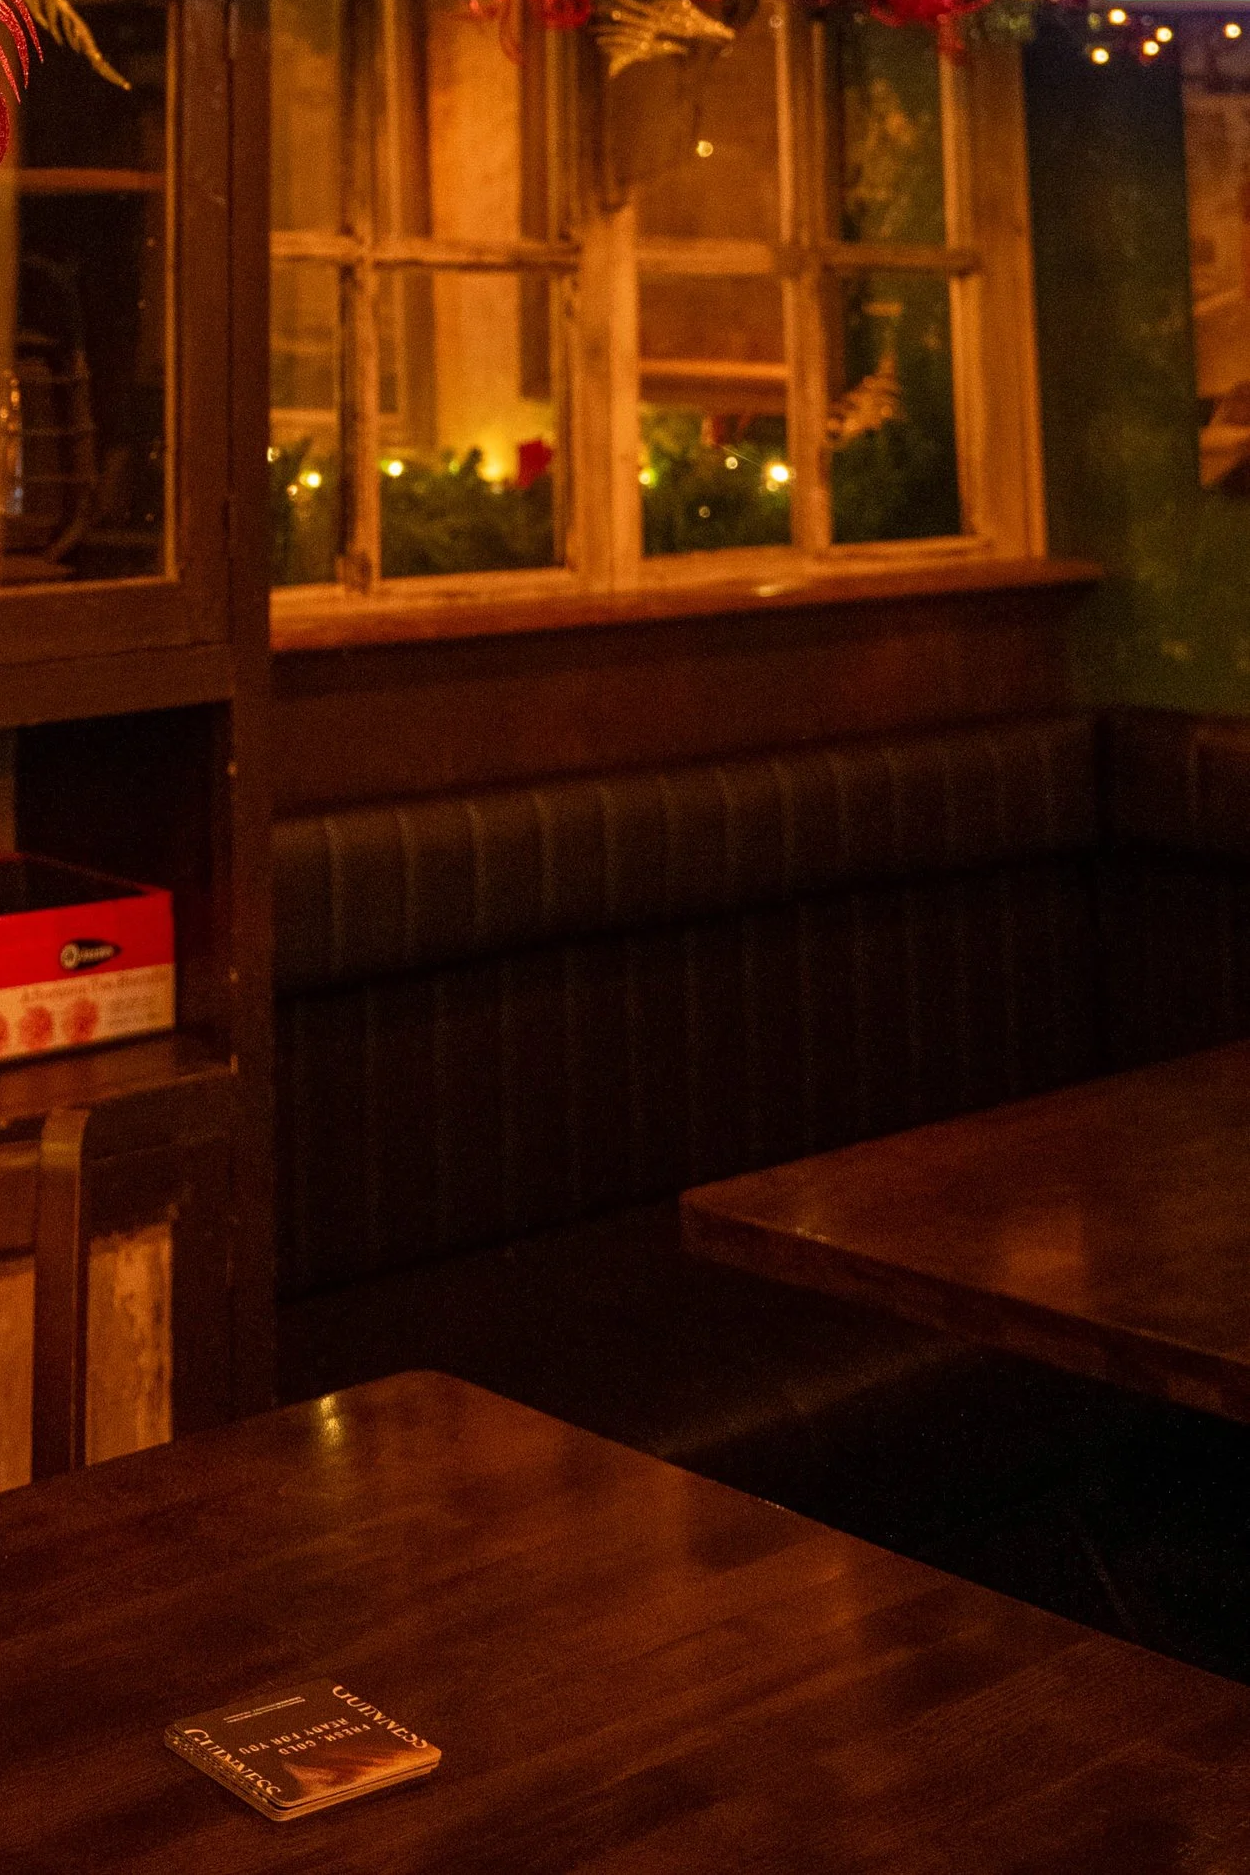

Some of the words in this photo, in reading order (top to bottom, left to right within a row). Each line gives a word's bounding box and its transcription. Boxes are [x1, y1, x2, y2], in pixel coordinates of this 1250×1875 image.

[303, 1717, 350, 1737] READY
[317, 1723, 371, 1742] FRESH,
[270, 1732, 301, 1746] FOR
[238, 1742, 270, 1755] YOU
[278, 1740, 317, 1756] COLD
